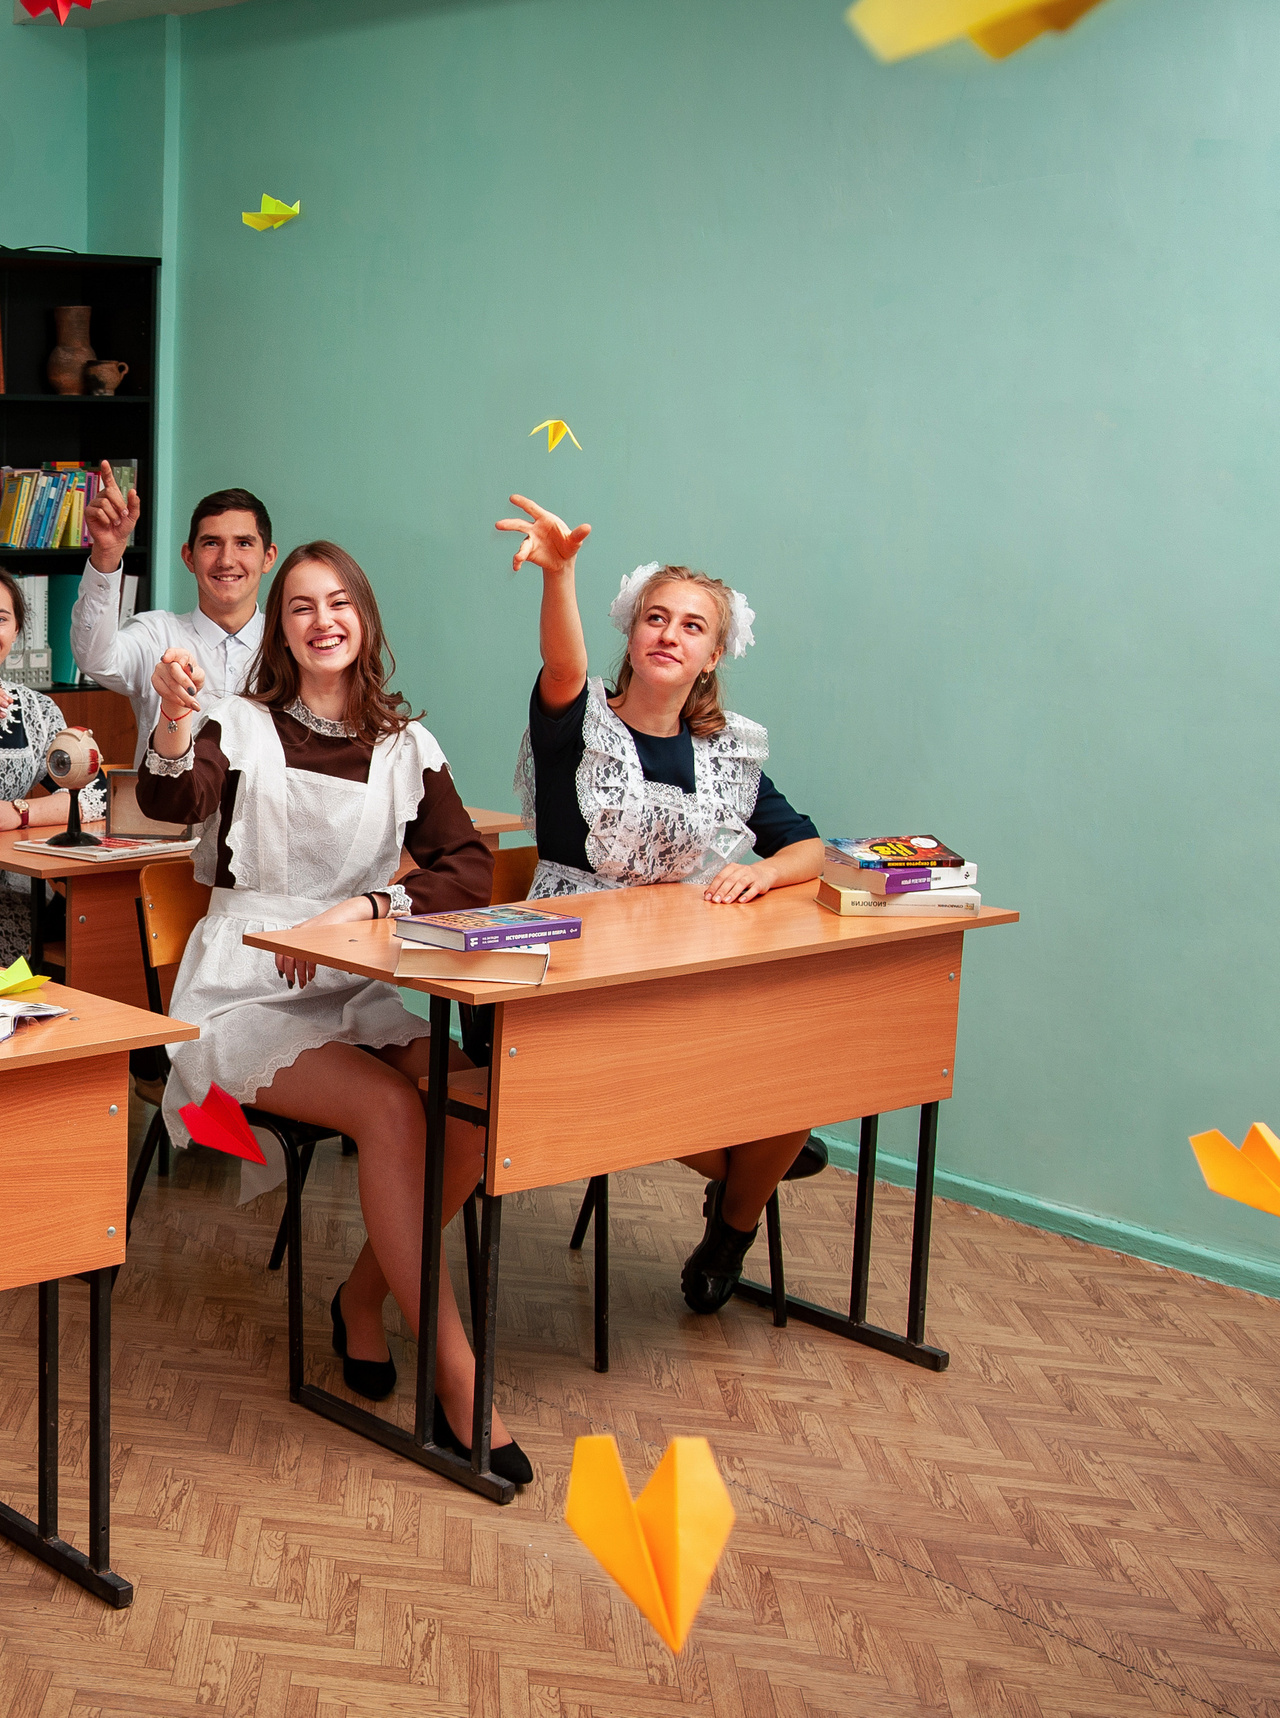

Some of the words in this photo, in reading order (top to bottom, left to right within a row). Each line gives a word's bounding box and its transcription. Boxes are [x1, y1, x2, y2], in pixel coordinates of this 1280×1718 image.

[851, 900, 887, 908] БИОЛОГИЯ
[505, 933, 528, 941] ИСТОРИЯ
[470, 937, 479, 947] 11
